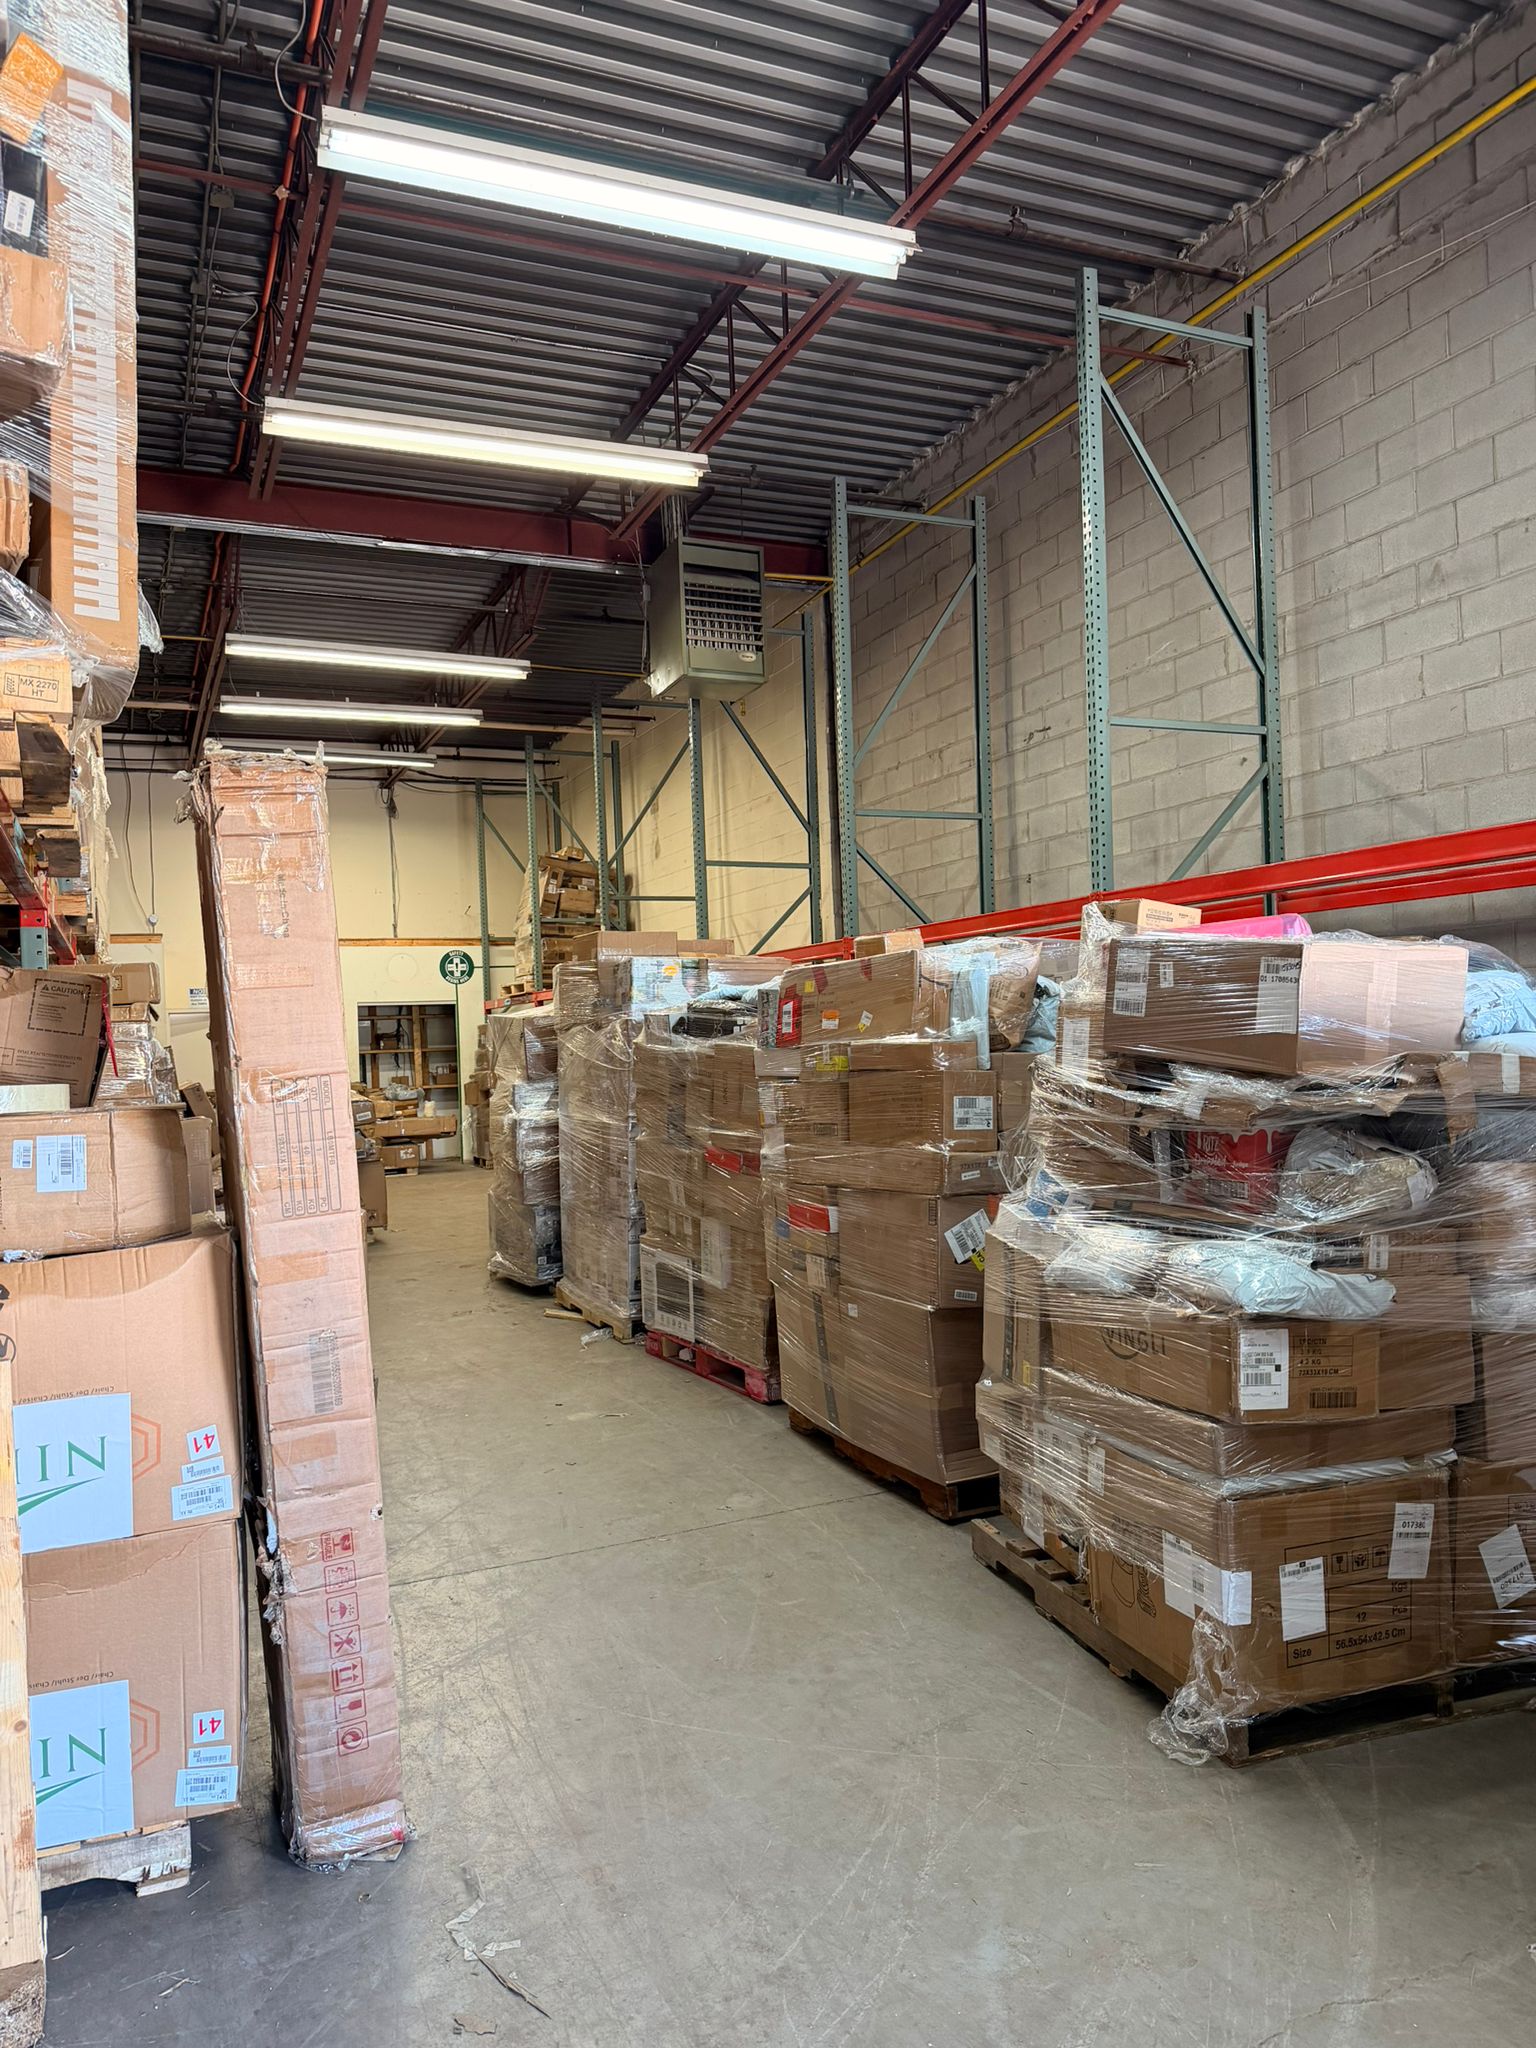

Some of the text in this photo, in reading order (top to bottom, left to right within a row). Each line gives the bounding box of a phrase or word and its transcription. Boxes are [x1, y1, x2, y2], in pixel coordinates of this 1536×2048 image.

[20, 677, 34, 688] MX
[36, 680, 58, 691] 2270
[31, 688, 45, 698] HT
[50, 984, 84, 996] CAUTION
[322, 1080, 331, 1105] MODEL
[310, 1086, 319, 1102] QTY
[319, 1197, 328, 1208] PC
[283, 1201, 292, 1214] CM
[295, 1200, 304, 1212] KG
[307, 1199, 316, 1211] KG
[1103, 1327, 1167, 1357] VINGLI
[1311, 1358, 1322, 1366] KG
[193, 1432, 215, 1454] 41
[323, 1533, 334, 1560] FRAGILE
[1391, 1581, 1408, 1593] Kgs
[1355, 1605, 1409, 1623] 12 Pcs
[1292, 1627, 1406, 1660] Size 56.5x54x42.5 Cm
[50, 1677, 75, 1687] Stuhl/
[76, 1674, 90, 1682] Der
[90, 1671, 115, 1681] Chair/
[198, 1717, 222, 1737] 41
[37, 1726, 107, 1779] IN
